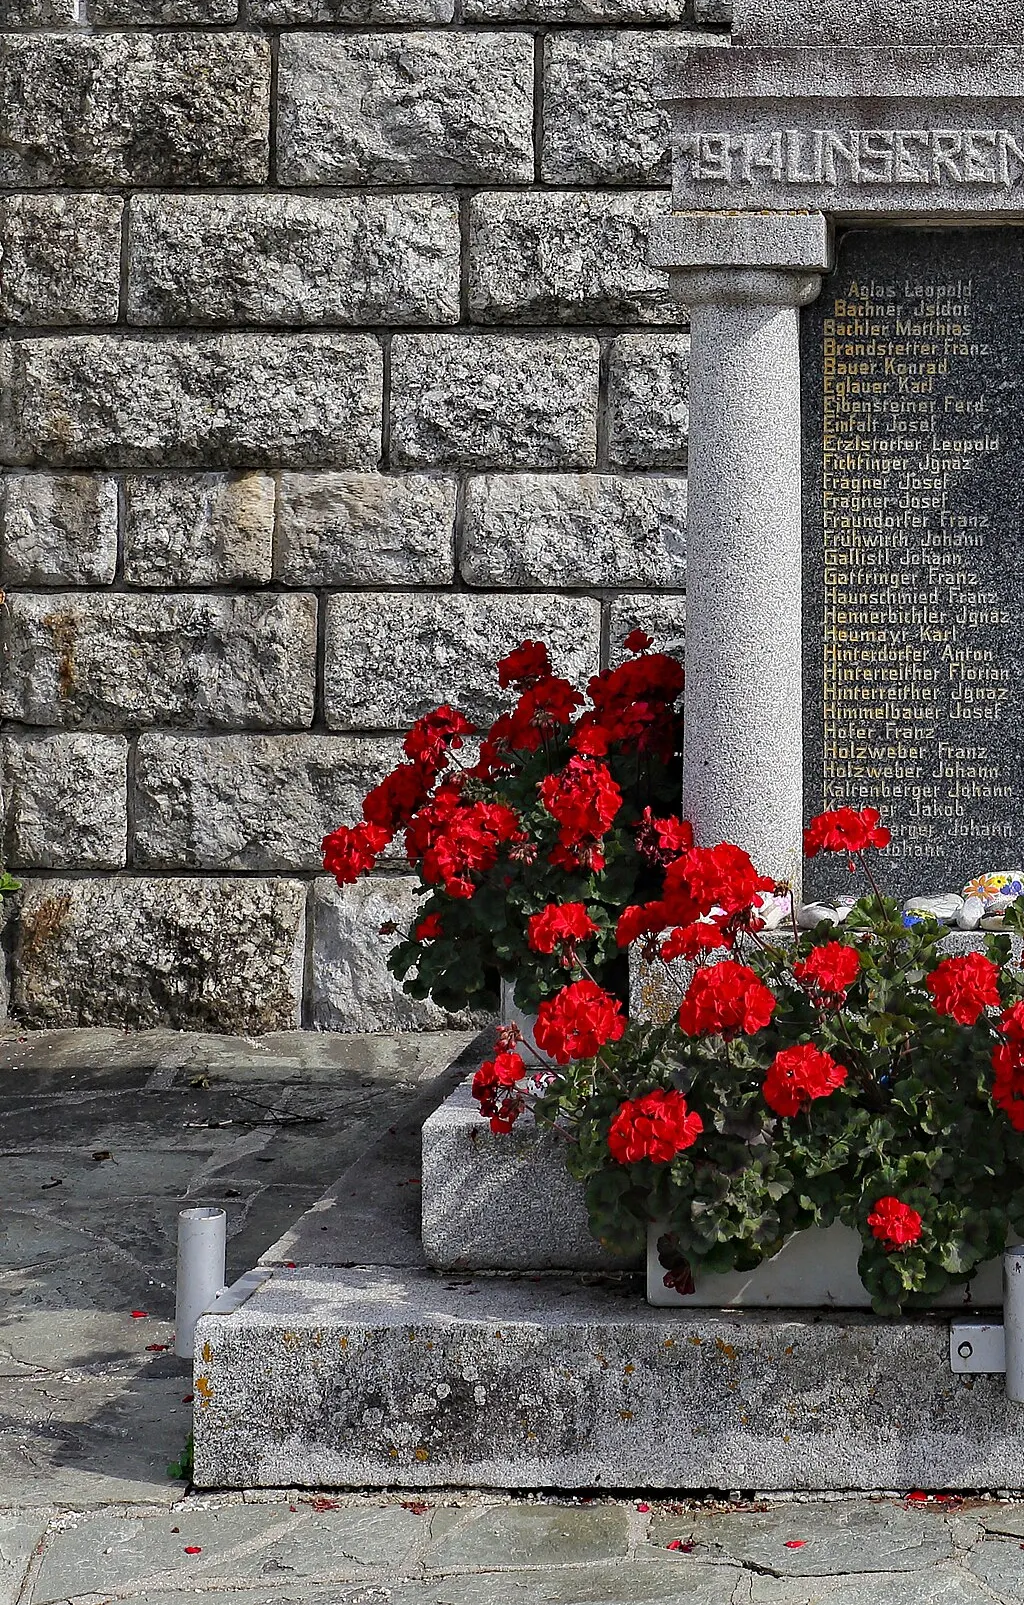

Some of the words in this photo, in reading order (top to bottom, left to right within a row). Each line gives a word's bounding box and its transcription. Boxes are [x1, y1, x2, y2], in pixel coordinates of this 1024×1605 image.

[904, 281, 973, 300] Leopold
[896, 319, 972, 336] Matthias
[823, 338, 941, 355] Brandstetter
[944, 338, 990, 355] Franz
[823, 357, 877, 374] Bauer
[884, 357, 948, 374] Konrad
[823, 376, 890, 397] Eglauer
[898, 376, 933, 393] Karl
[823, 396, 937, 412] Eibensteiner
[823, 415, 878, 432] Einfalt
[886, 415, 937, 432] Josef
[932, 434, 1000, 453] Leopold
[823, 472, 890, 493] Fragner
[899, 472, 950, 489] Josef
[823, 491, 893, 512] Fragner
[899, 491, 949, 508] Josef
[823, 511, 929, 528] Fraundorfer
[940, 511, 990, 528] Franz
[823, 530, 909, 547] Frühwirth
[921, 530, 984, 547] Johann
[899, 549, 962, 566] Johann
[928, 568, 978, 585] Franz
[824, 587, 939, 604] Haunschmied
[949, 587, 998, 604] Franz
[823, 607, 947, 624] Hennerbichler
[919, 626, 957, 643] Karl
[941, 645, 994, 662] Anton
[823, 665, 940, 682] Hinterreither
[949, 665, 1010, 682] Florian
[823, 684, 940, 701] Hinterreither
[823, 703, 941, 720] Himmelbauer
[949, 703, 1002, 720] Josef
[823, 723, 875, 740] Hofer
[885, 723, 935, 740] Franz
[823, 742, 926, 759] Holzweber
[937, 742, 988, 759] Franz
[823, 761, 924, 778] Holzweber
[932, 761, 999, 778] Johann
[823, 781, 940, 802] Kaltenberger
[948, 781, 1013, 798] Johann
[909, 800, 965, 817] Jakob
[948, 820, 1013, 837] Johann
[878, 839, 945, 856] Johann
